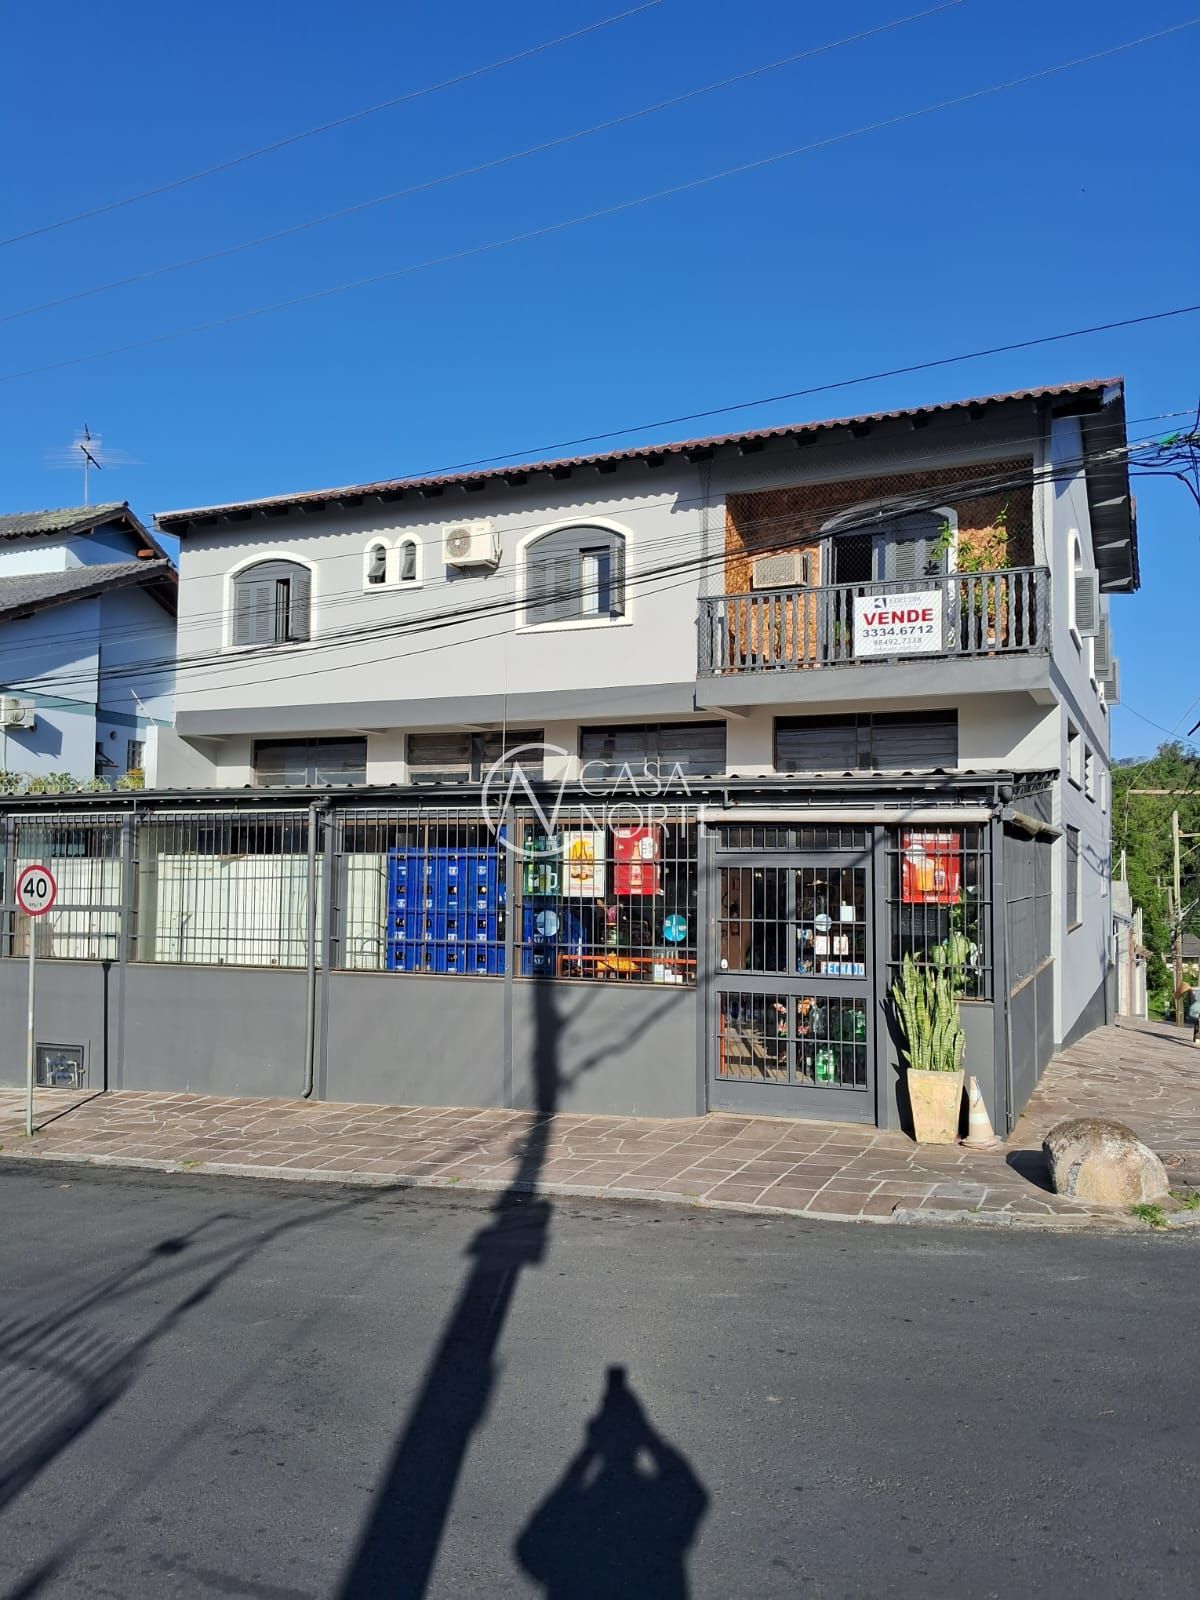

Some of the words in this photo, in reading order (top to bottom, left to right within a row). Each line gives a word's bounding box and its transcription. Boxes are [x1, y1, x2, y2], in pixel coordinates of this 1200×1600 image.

[863, 608, 934, 626] VENDE
[862, 625, 933, 638] 3334.6712
[24, 878, 47, 898] 40
